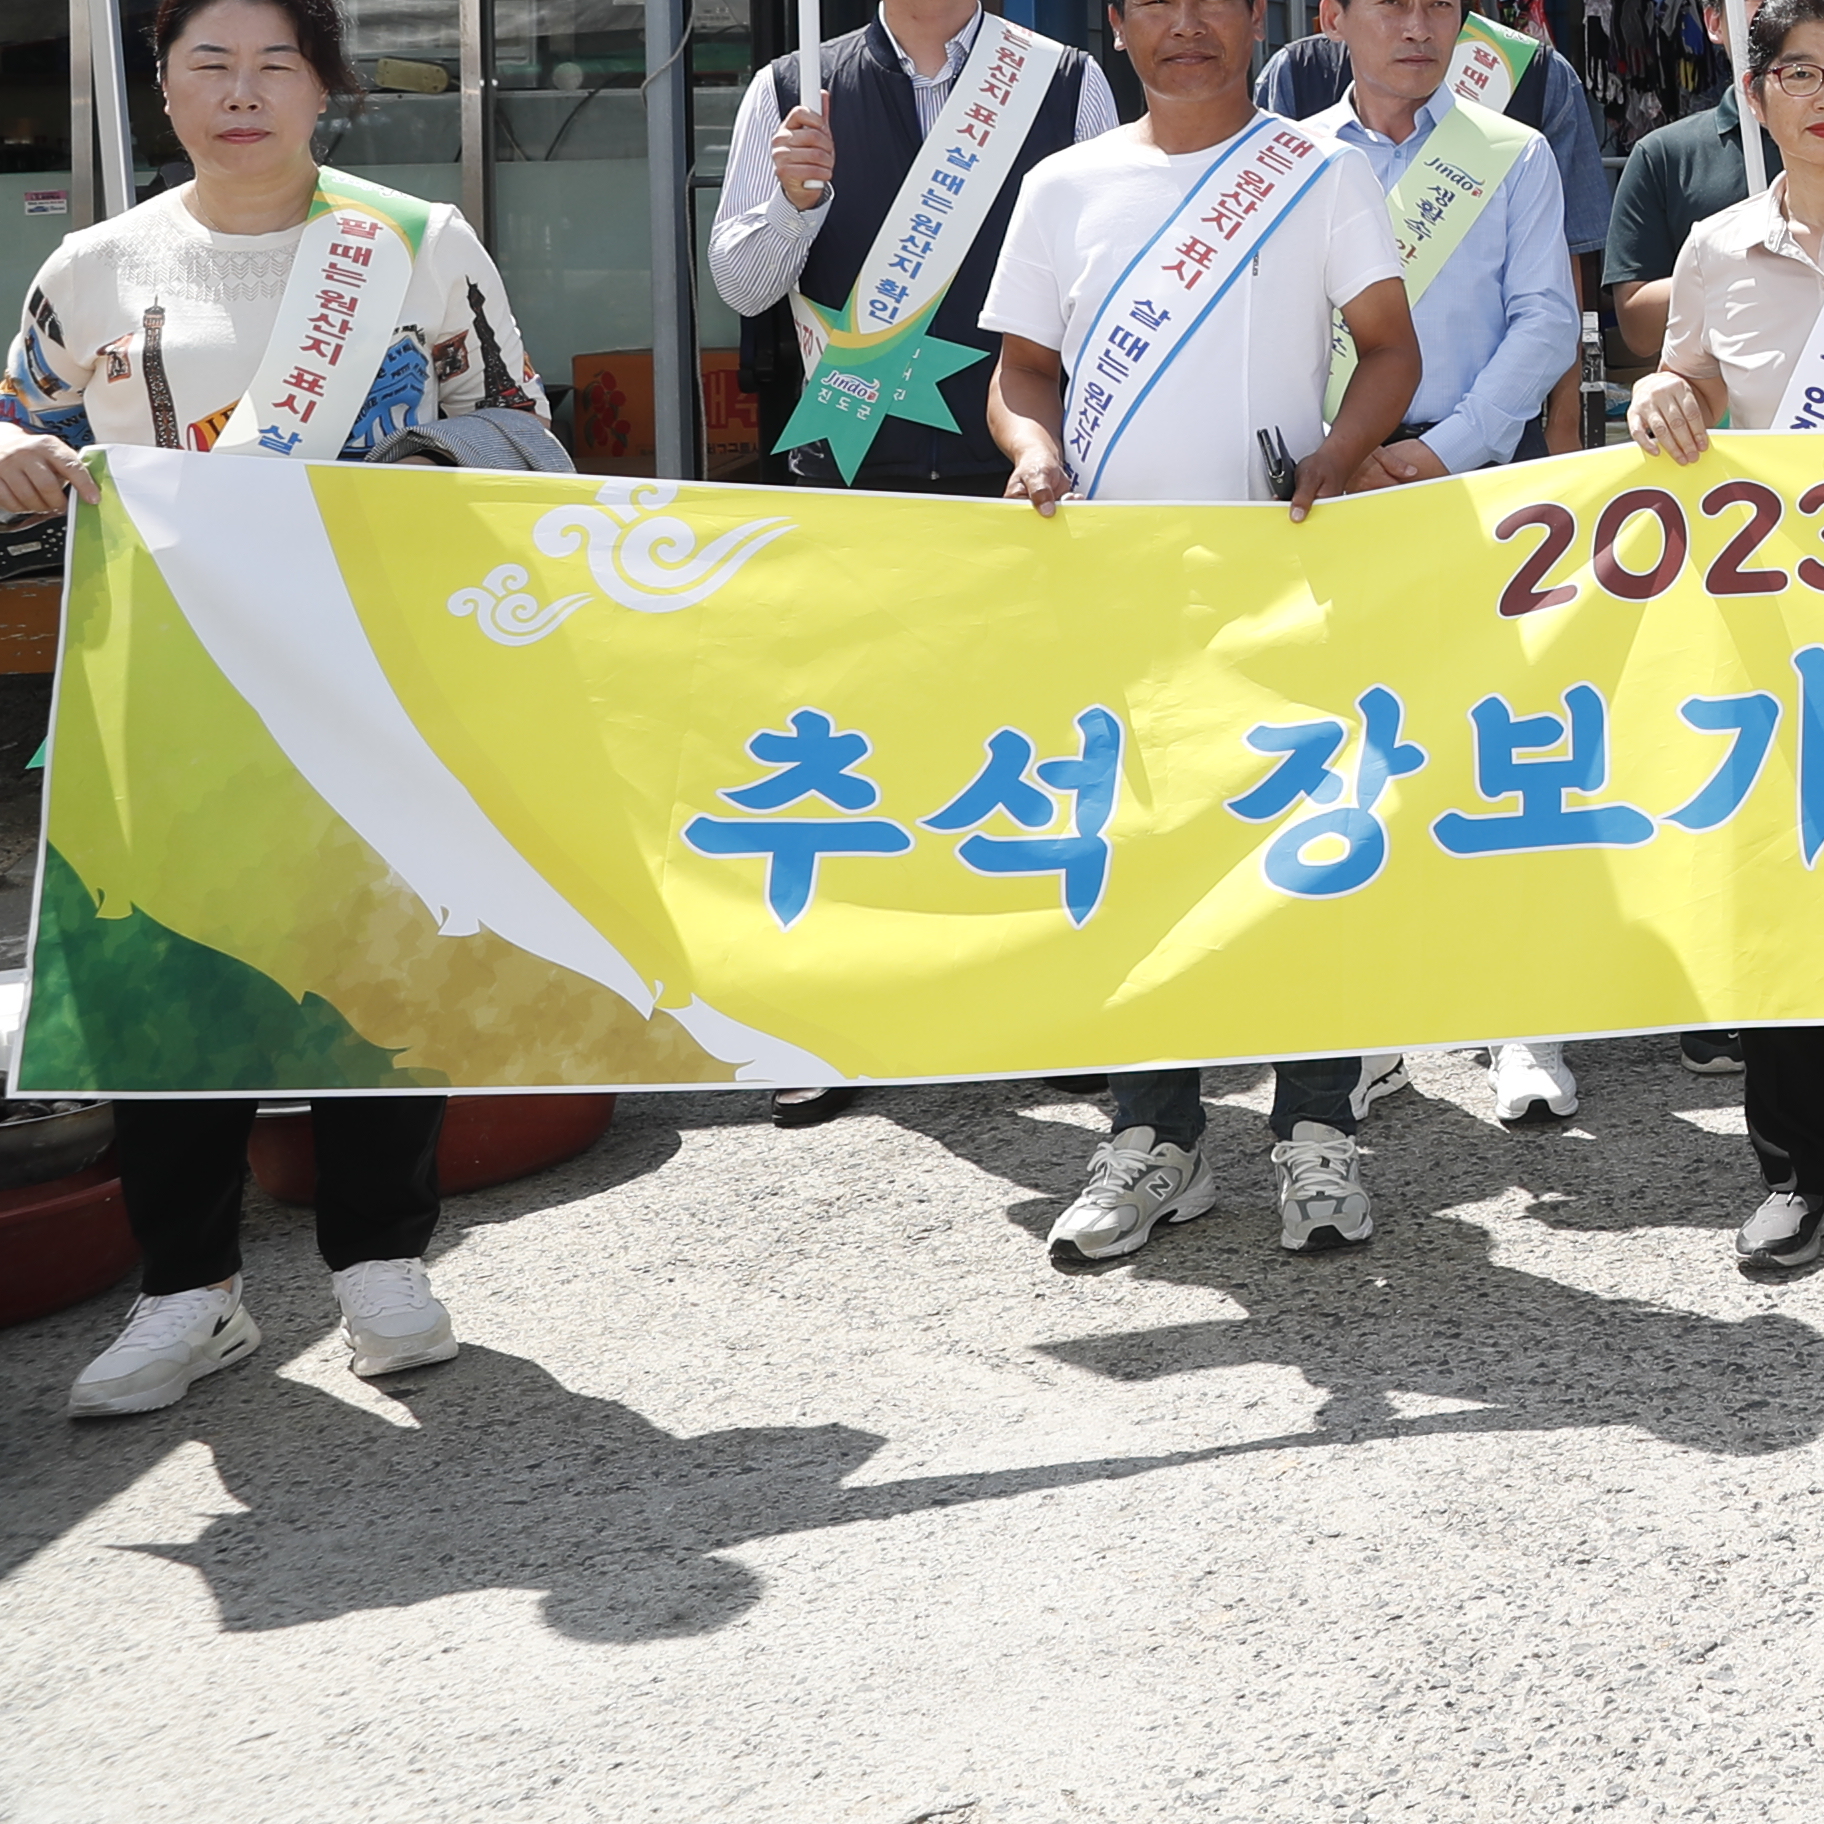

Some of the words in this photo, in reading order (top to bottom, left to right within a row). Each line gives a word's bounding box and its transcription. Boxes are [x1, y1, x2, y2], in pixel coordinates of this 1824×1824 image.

[1256, 128, 1315, 178] 때는
[1423, 156, 1474, 192] Jindo
[336, 216, 384, 241] 팔
[1201, 168, 1277, 243] 원산지
[320, 241, 373, 289] 때는
[1160, 235, 1220, 294] 표시
[299, 288, 360, 367] 원산지
[868, 276, 911, 326] 확인
[1128, 296, 1173, 334] 살
[1096, 322, 1153, 385] 때는
[270, 364, 328, 425] 표시
[1069, 378, 1117, 465] 원산지
[256, 423, 304, 457] 살
[684, 703, 1124, 928] 추석
